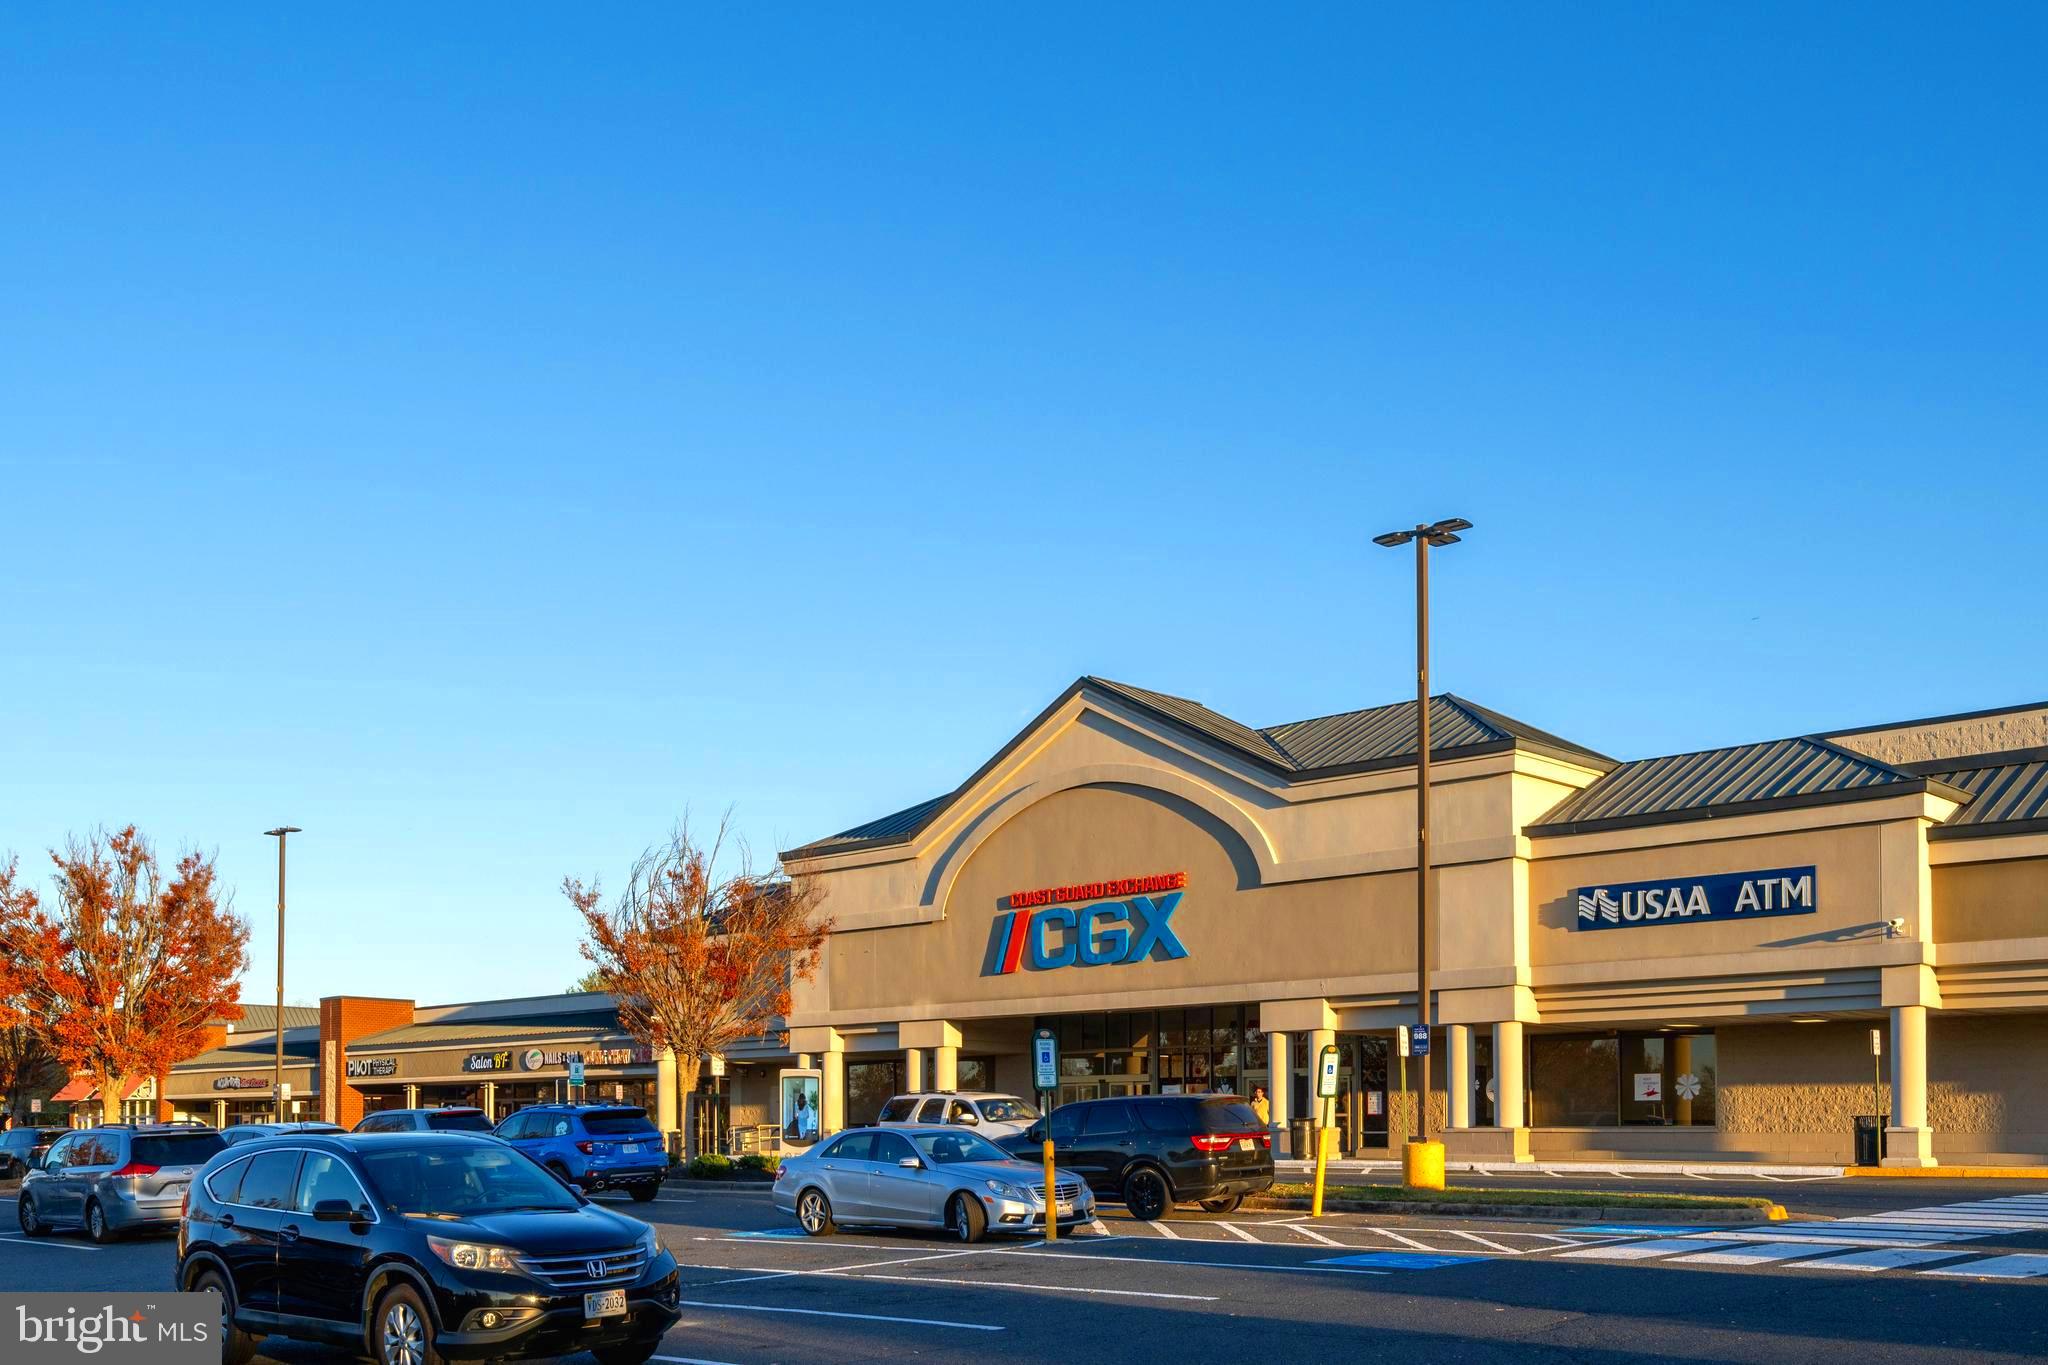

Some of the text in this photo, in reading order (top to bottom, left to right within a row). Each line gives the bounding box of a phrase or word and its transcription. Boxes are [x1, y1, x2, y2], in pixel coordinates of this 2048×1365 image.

[1010, 871, 1188, 908] COAST GUARD EXCHANGE
[1622, 875, 1812, 921] USAA ATM
[1032, 892, 1190, 969] CGX
[372, 1058, 396, 1067] PHYSICAL
[470, 1055, 493, 1070] Salon
[544, 1052, 562, 1064] NAILS
[348, 1059, 372, 1075] PIVOT
[373, 1066, 395, 1075] THERAPY
